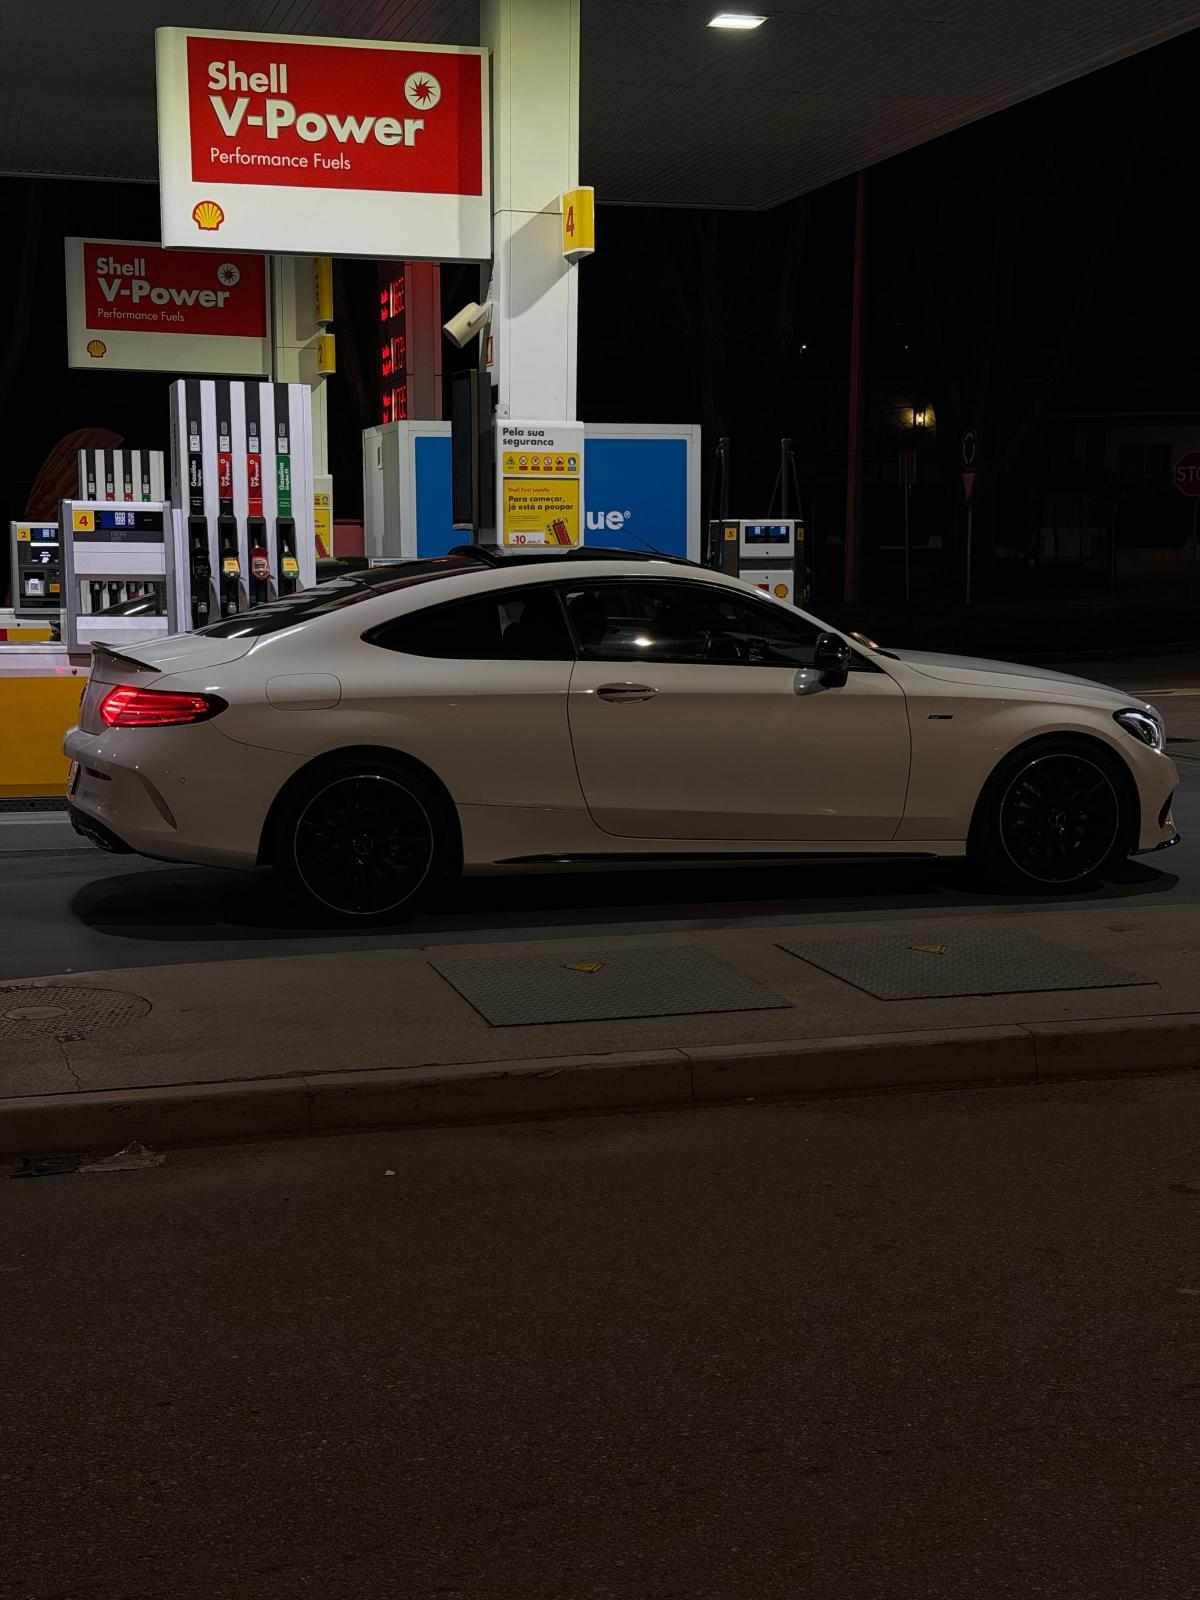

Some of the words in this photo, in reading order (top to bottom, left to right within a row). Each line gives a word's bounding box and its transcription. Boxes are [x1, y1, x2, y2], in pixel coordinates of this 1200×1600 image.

[208, 61, 288, 94] Shell
[208, 94, 426, 147] V-Power
[210, 147, 308, 169] Performance
[313, 153, 351, 171] Fuels
[566, 206, 575, 238] 4
[96, 256, 145, 277] Shell
[96, 277, 231, 309] V-Power
[97, 308, 158, 321] Performance
[161, 310, 185, 322] Fuels
[503, 427, 524, 436] Pela
[544, 504, 574, 512] poupar
[79, 515, 89, 526] 4
